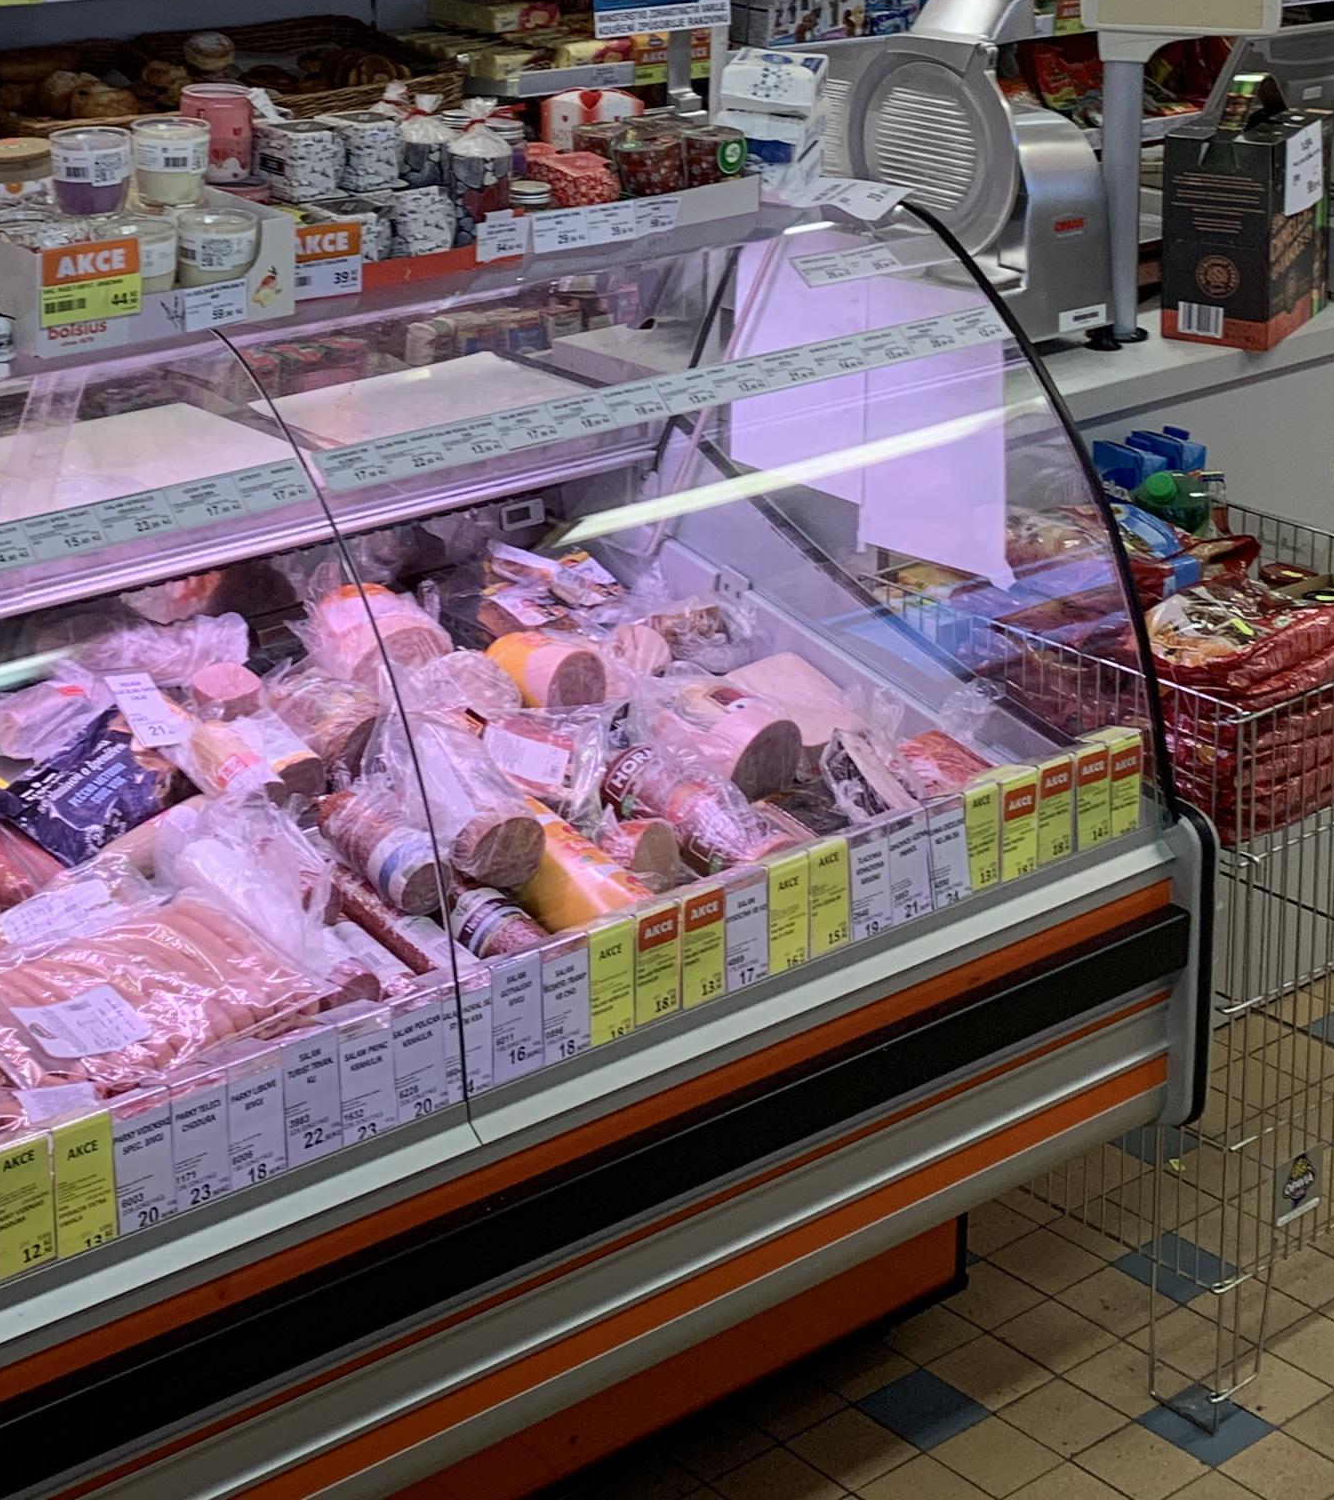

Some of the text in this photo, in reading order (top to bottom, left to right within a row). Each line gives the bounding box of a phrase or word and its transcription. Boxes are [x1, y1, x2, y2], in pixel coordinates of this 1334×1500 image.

[56, 248, 126, 278] AKCE
[148, 725, 166, 737] 21
[1081, 760, 1106, 776] AKCE
[1114, 755, 1138, 772] AKCE
[1044, 772, 1069, 789] AKCE
[971, 794, 991, 811] AKCE
[1008, 794, 1033, 812] AKCE
[818, 852, 841, 868] AKCE
[777, 875, 800, 892] AKCE
[690, 901, 719, 921] AKCE
[644, 919, 674, 940] AKCE
[828, 929, 842, 945] 15
[865, 920, 880, 937] 19
[599, 943, 623, 961] AKCE
[738, 967, 755, 985] 17
[701, 980, 715, 997] 13
[509, 1046, 527, 1065] 16
[559, 1039, 576, 1059] 18
[415, 1097, 433, 1119] 20
[303, 1127, 324, 1149] 22
[66, 1138, 98, 1162] AKCE
[3, 1149, 36, 1173] AKCE
[247, 1163, 268, 1183] 18
[190, 1184, 212, 1205] 23
[137, 1206, 159, 1228] 20
[22, 1244, 42, 1263] 12
